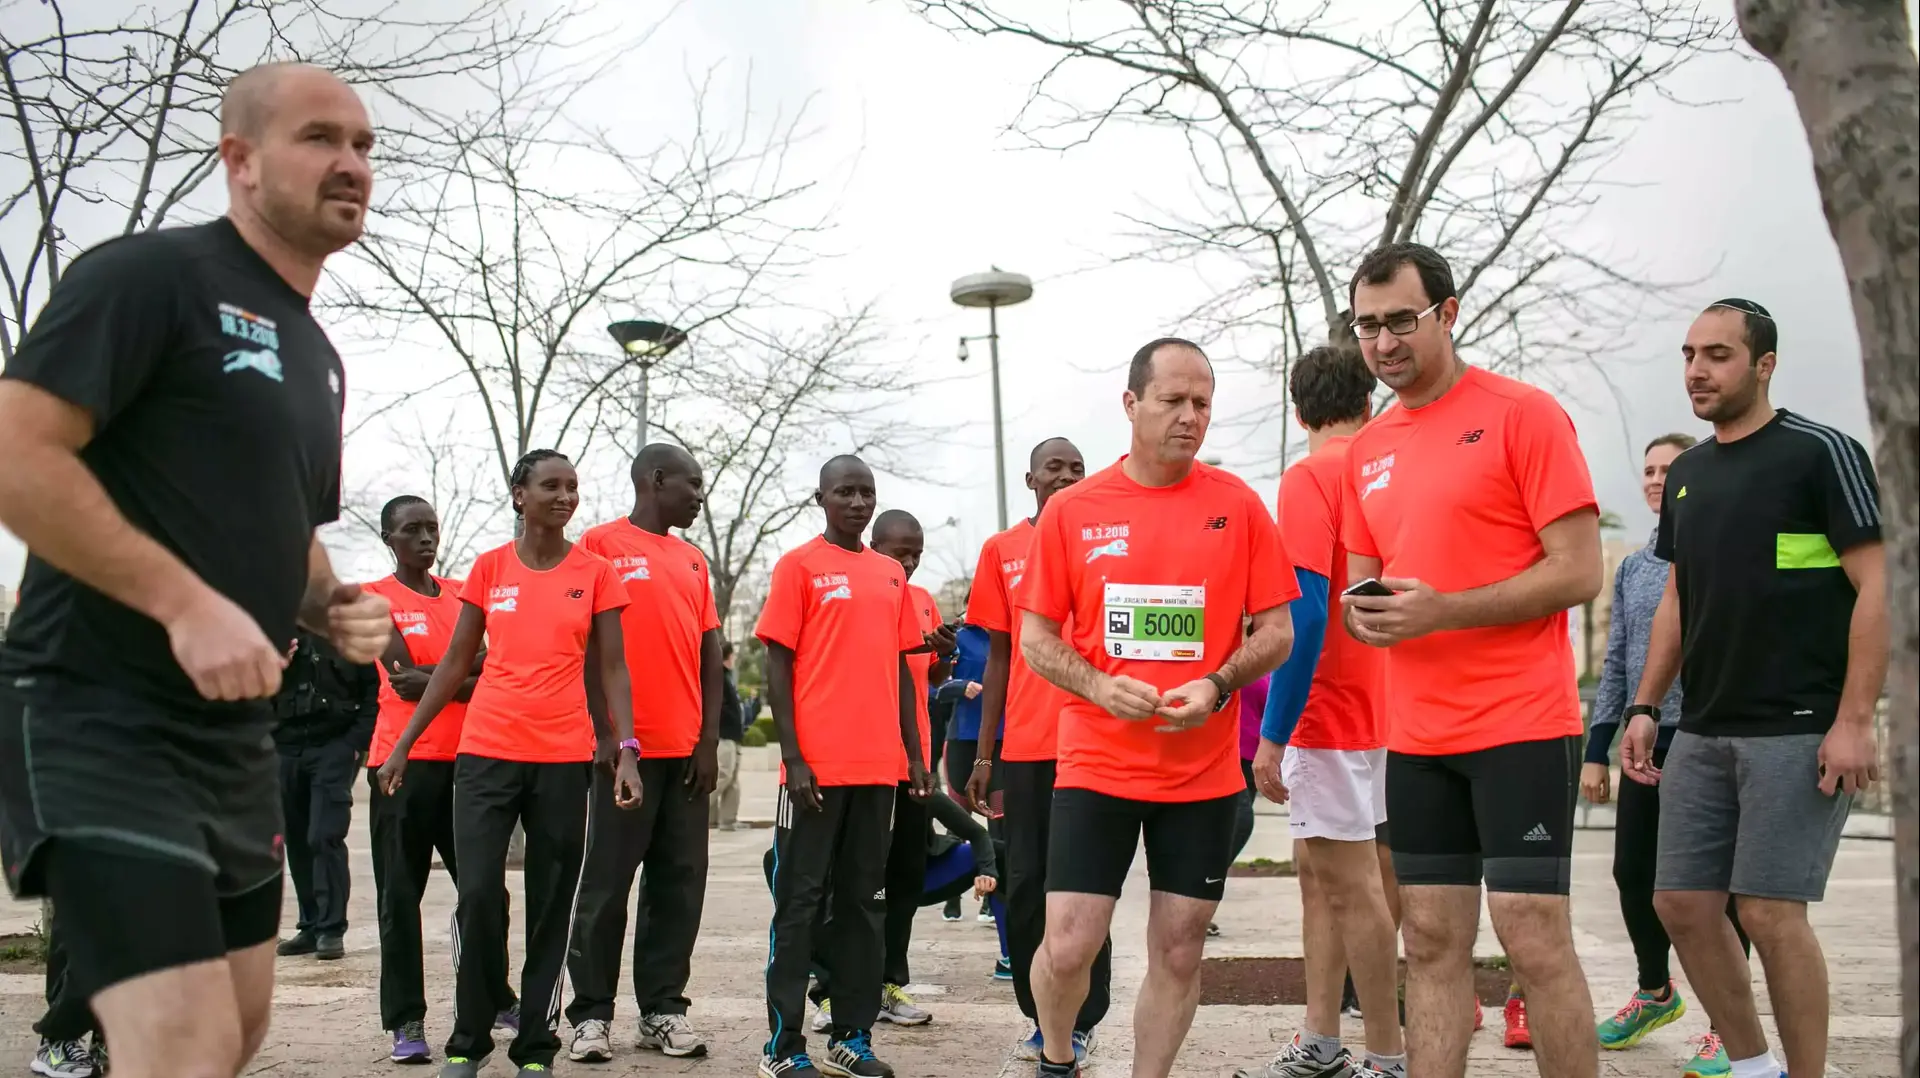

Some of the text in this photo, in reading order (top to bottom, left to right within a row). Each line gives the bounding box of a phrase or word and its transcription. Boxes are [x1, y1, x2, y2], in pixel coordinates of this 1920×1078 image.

[1082, 525, 1129, 541] 18.3.2016
[1144, 613, 1196, 637] 5000
[1114, 643, 1123, 656] B
